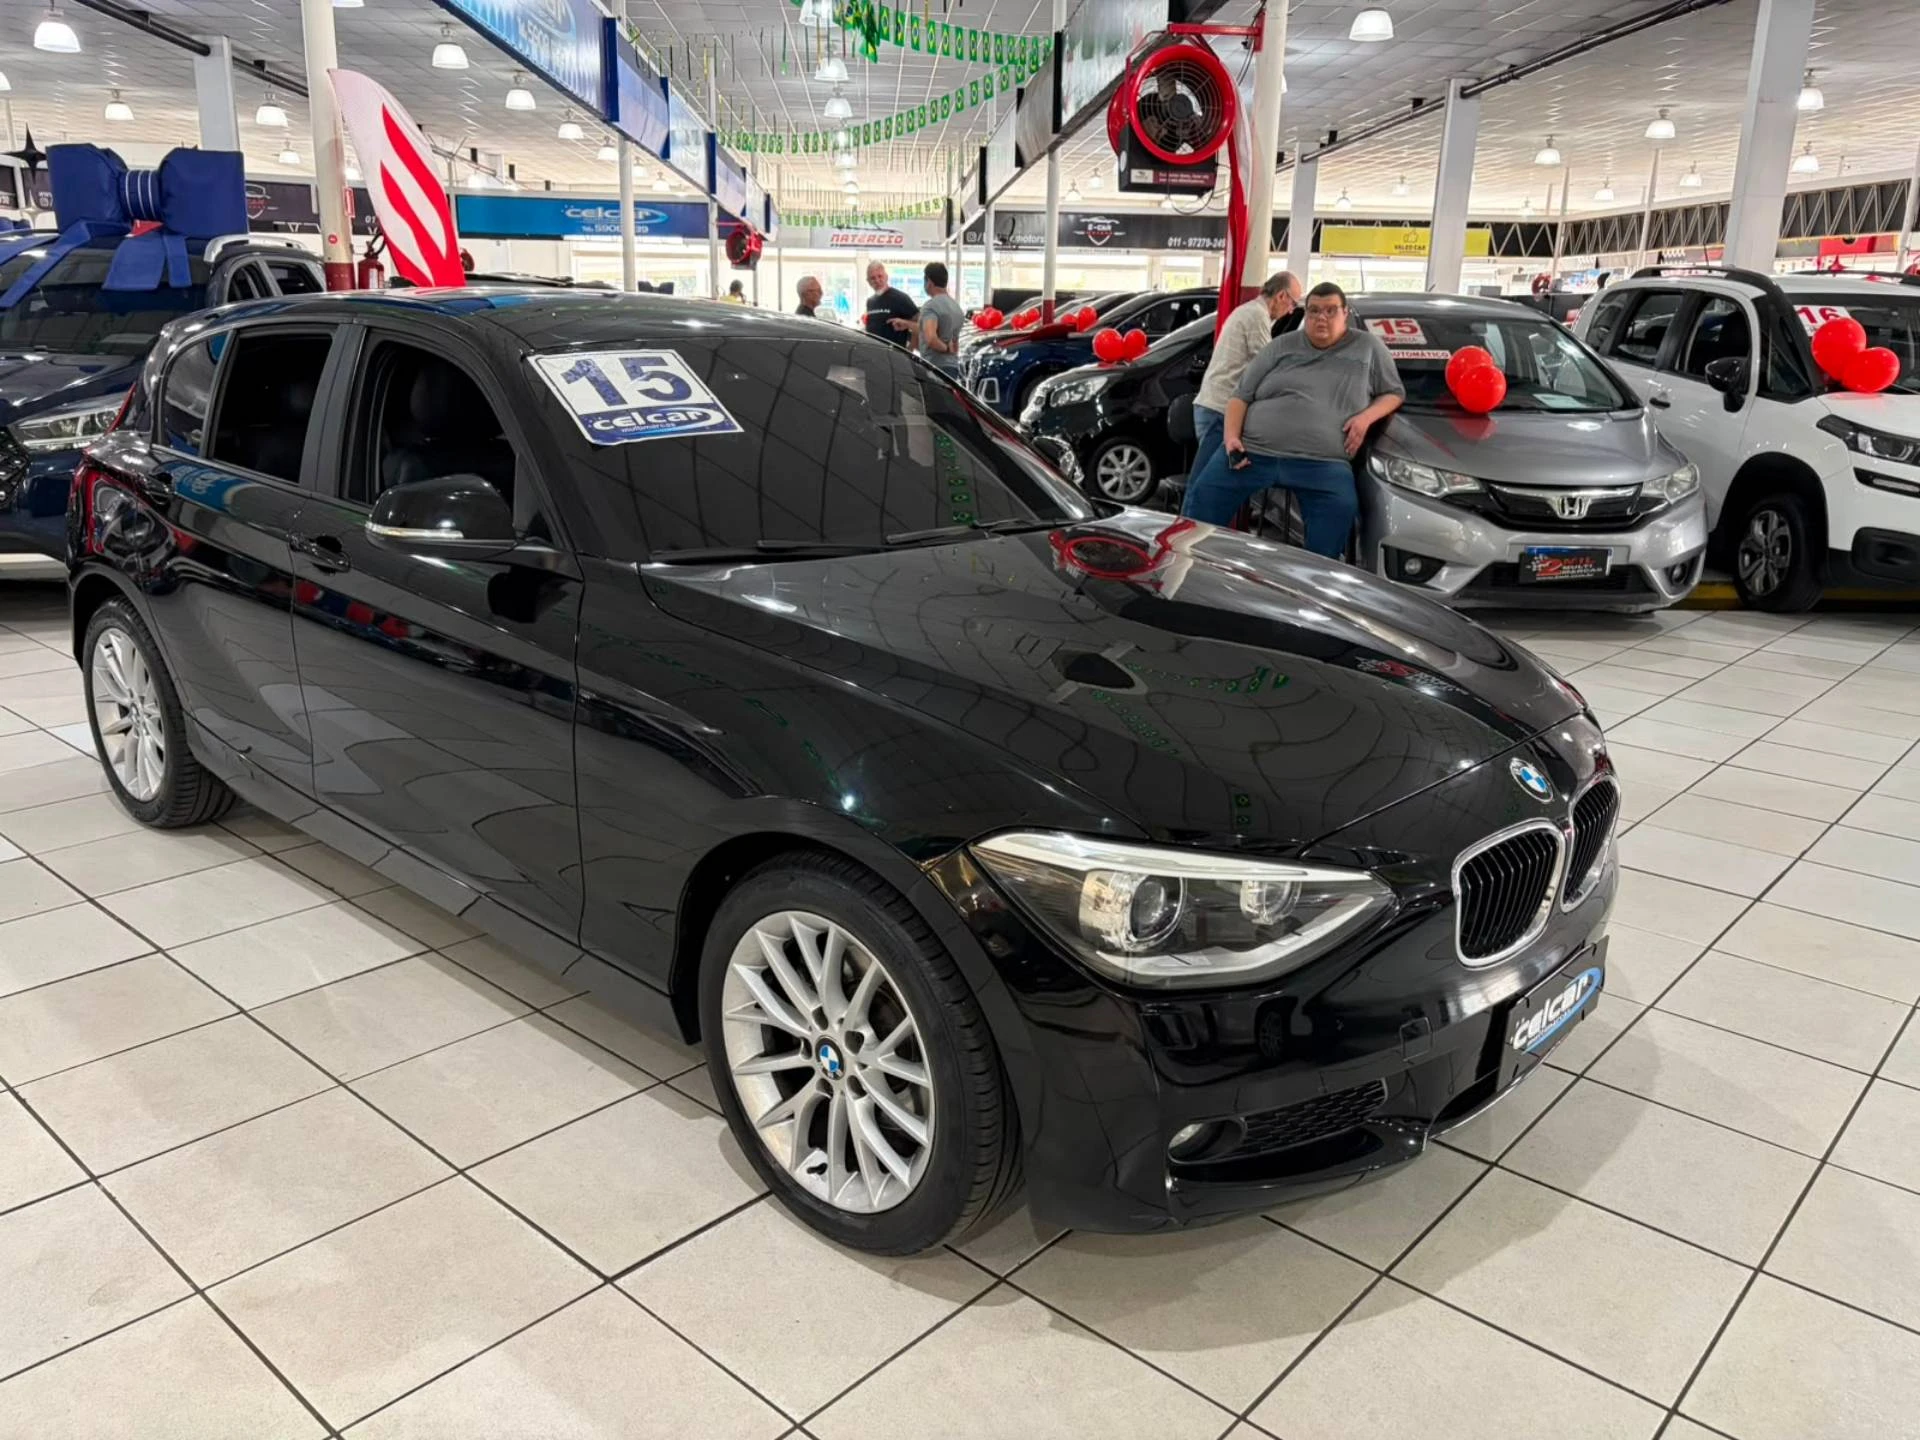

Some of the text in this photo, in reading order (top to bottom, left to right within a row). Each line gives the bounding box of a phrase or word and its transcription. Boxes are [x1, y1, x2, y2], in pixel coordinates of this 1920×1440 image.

[566, 206, 651, 219] celcr
[1373, 320, 1418, 335] 15
[561, 356, 692, 407] 15
[593, 411, 704, 431] celcar
[1513, 974, 1588, 1050] celcar
